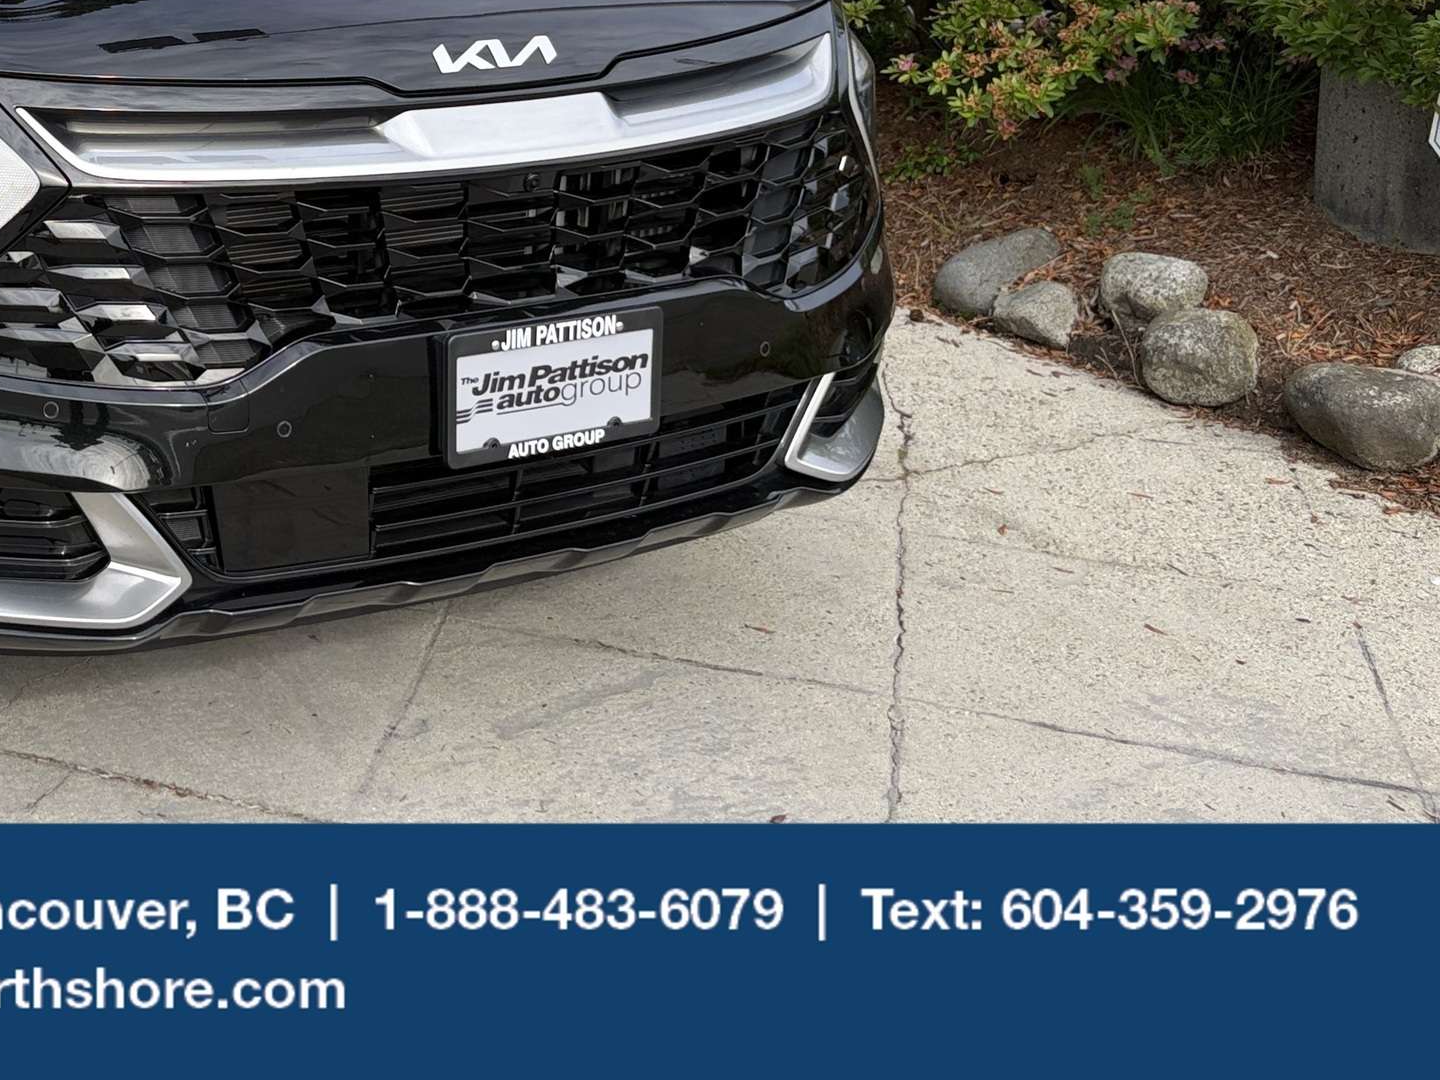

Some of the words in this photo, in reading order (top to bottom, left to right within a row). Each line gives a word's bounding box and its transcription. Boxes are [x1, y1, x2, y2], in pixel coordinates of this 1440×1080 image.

[501, 326, 532, 351] JIM
[536, 315, 617, 346] PATTISON
[461, 376, 479, 386] The
[472, 371, 526, 397] Jim
[528, 353, 649, 388] Pattison
[508, 438, 550, 459] AUTO
[552, 428, 606, 451] GROUP
